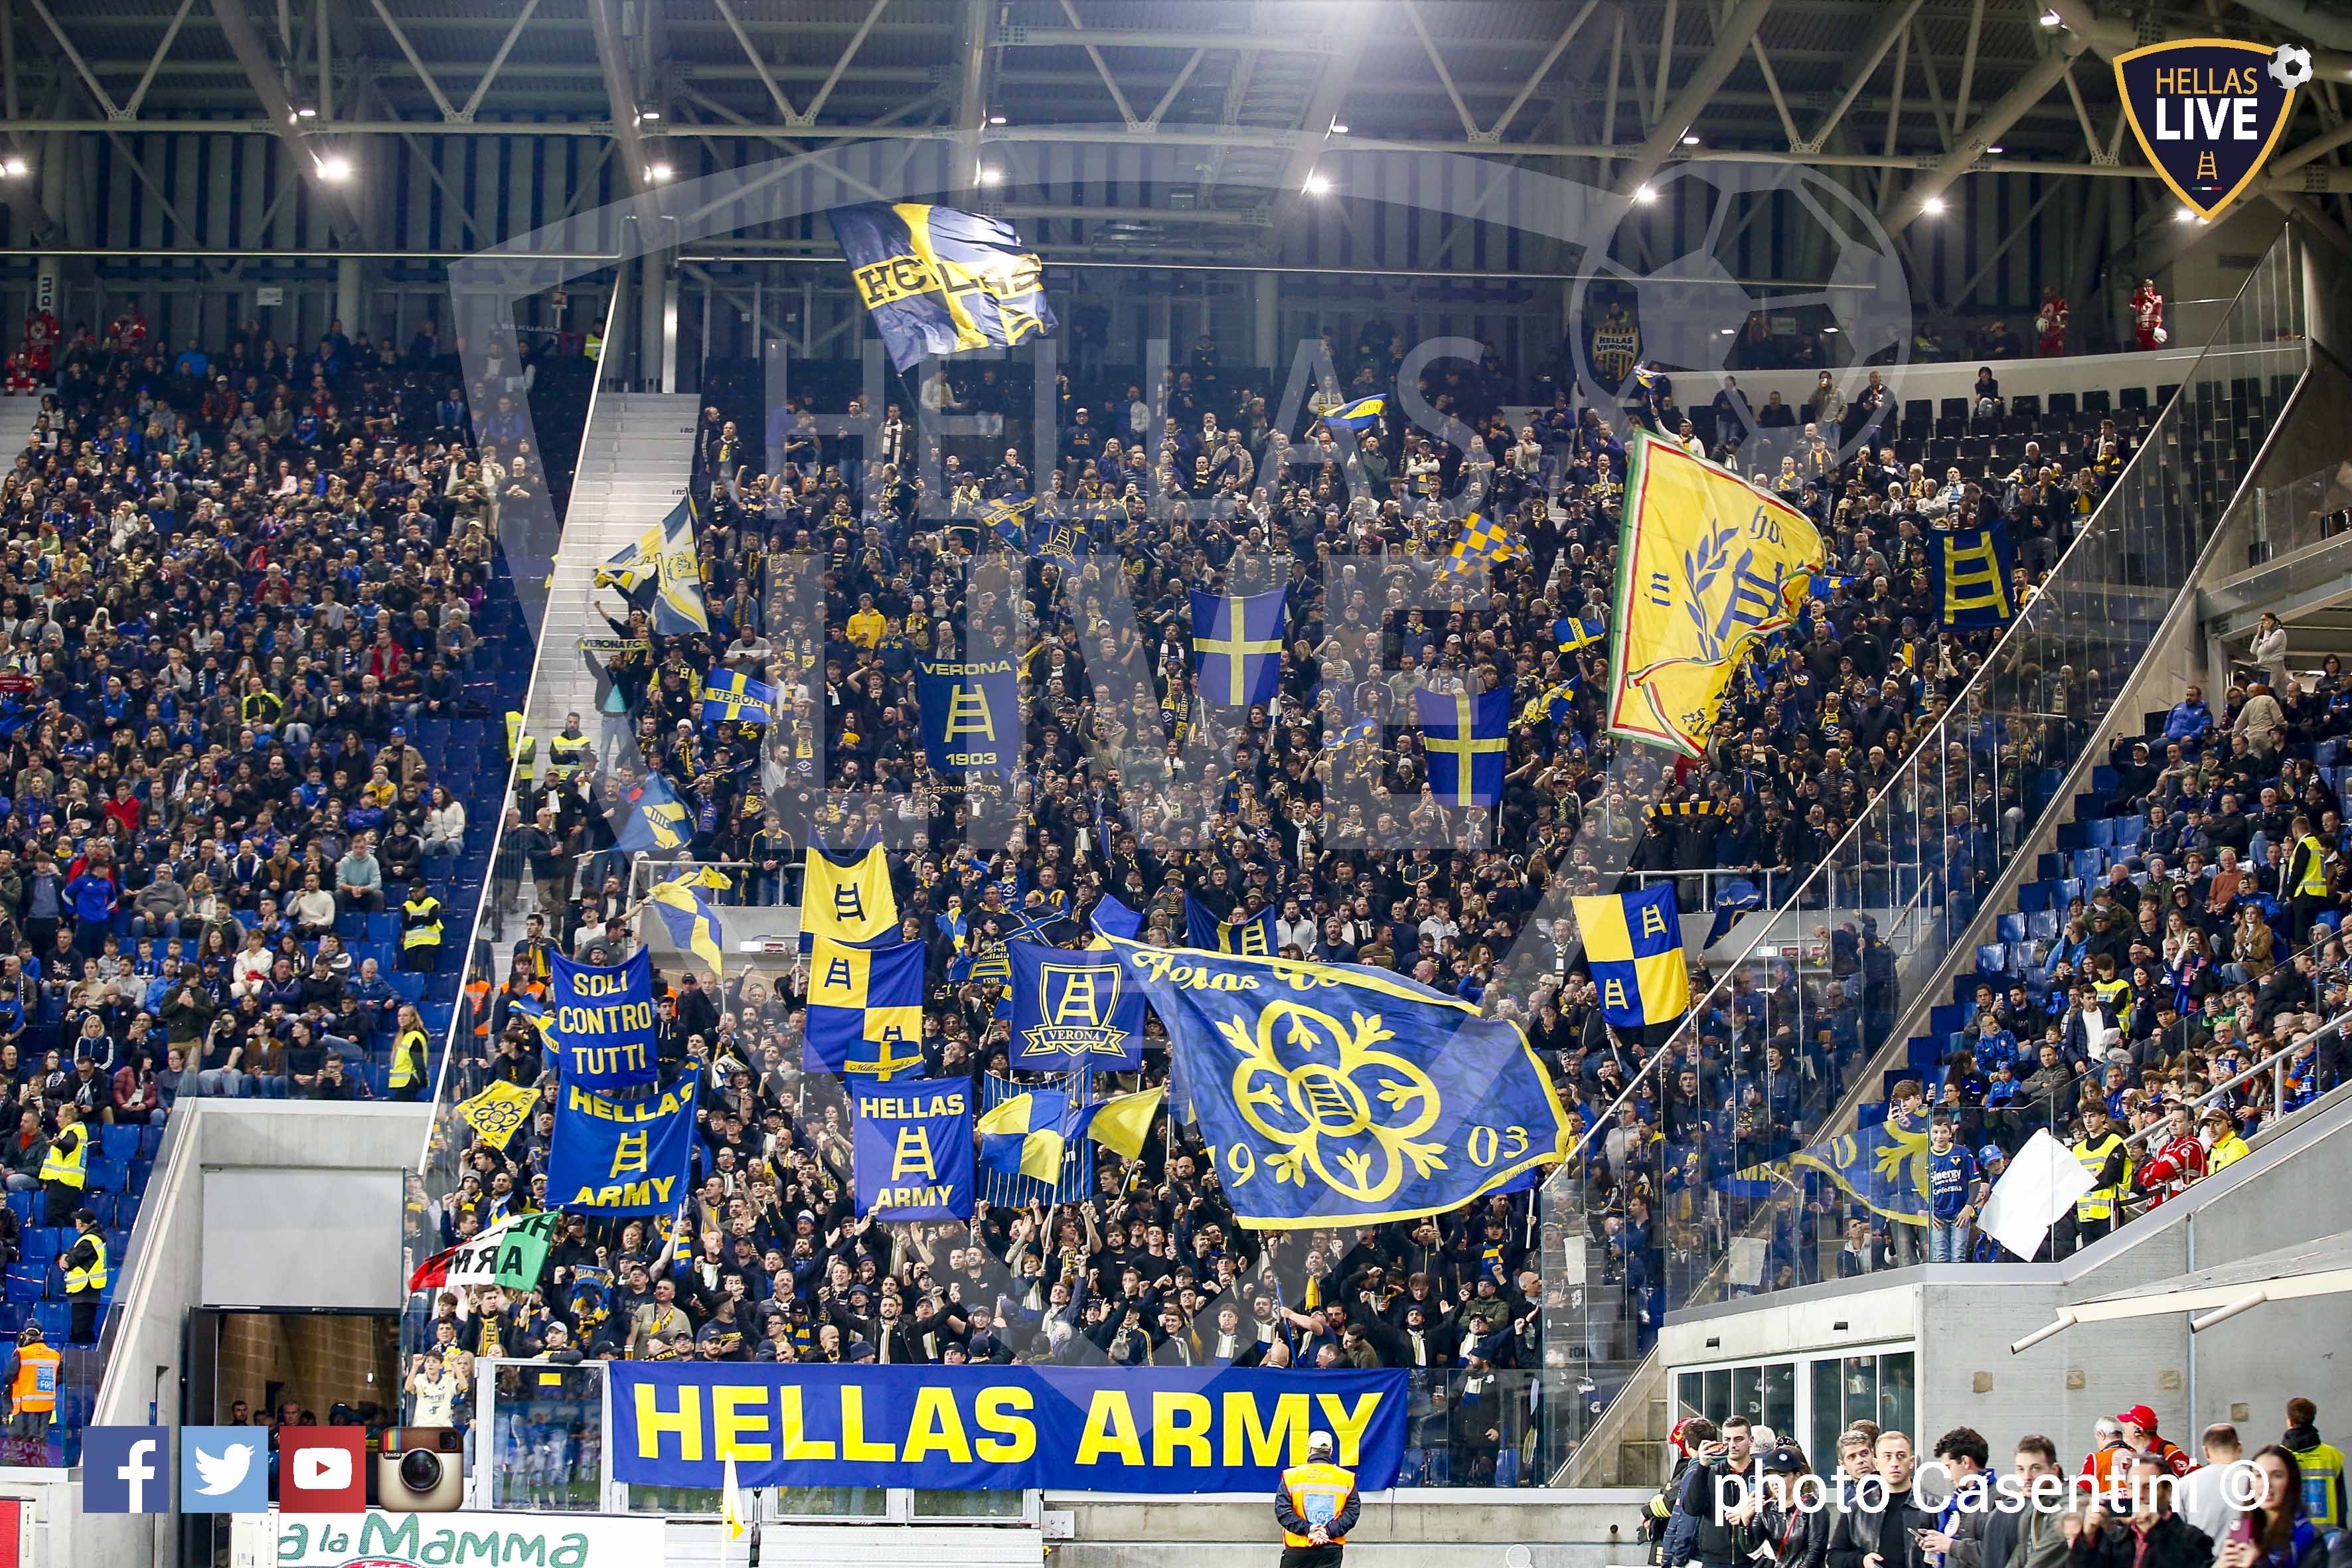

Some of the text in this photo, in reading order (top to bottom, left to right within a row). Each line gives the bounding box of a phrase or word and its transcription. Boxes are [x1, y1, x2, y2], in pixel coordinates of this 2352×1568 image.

[583, 639, 623, 649] VERONA
[920, 660, 1012, 676] VERONA
[945, 752, 997, 765] 1903
[573, 969, 628, 996] SOLI
[558, 1001, 653, 1035] CONTRO
[1048, 1030, 1101, 1041] VERONA
[571, 1043, 647, 1075] TUTTI
[569, 1081, 695, 1123] HELLAS
[860, 1093, 965, 1119] HELLAS
[1468, 1126, 1529, 1168] 03
[570, 1175, 676, 1208] ARMY
[876, 1184, 955, 1209] ARMY
[634, 1383, 1384, 1467] HELLAS ARMY
[319, 1524, 349, 1553] la
[359, 1513, 589, 1568] Mamma
